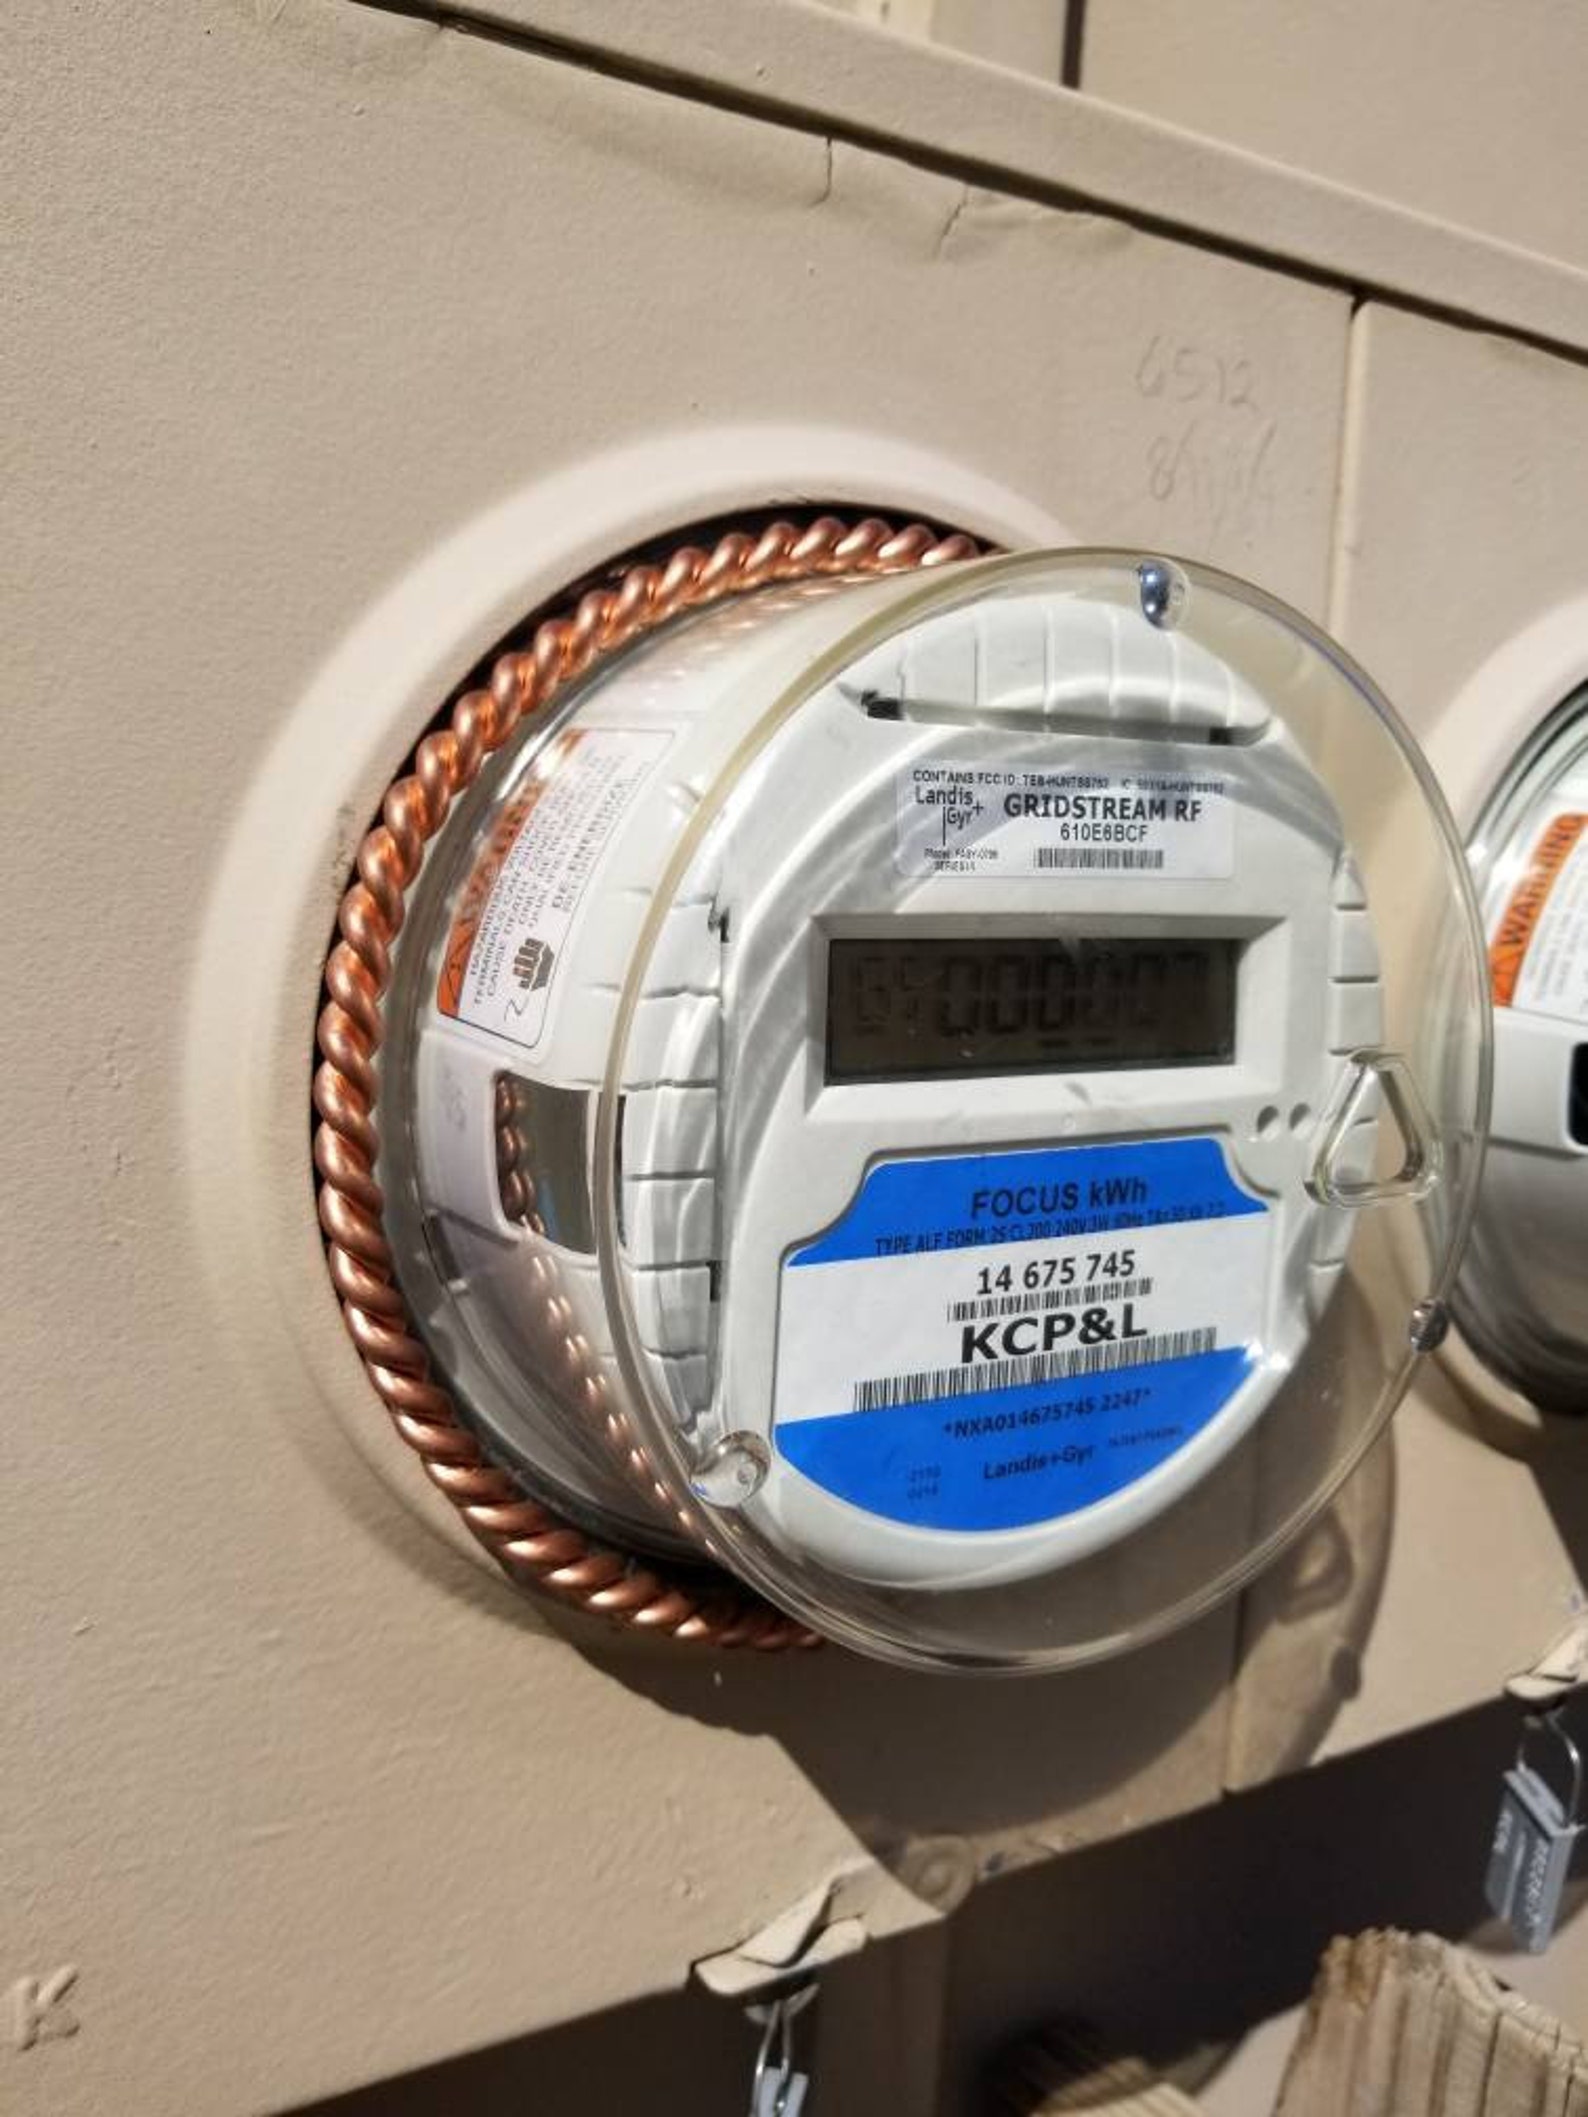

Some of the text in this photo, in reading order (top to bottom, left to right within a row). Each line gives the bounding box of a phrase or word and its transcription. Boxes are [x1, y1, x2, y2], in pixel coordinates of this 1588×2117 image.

[914, 785, 973, 805] Landis
[1004, 793, 1202, 822] GRIDSTREAM RF
[971, 1176, 1147, 1220] FOCUS kWh
[875, 1235, 912, 1256] TYPE
[947, 1228, 986, 1249] FORM
[977, 1249, 1136, 1295] 14 675 745
[961, 1304, 1147, 1363] KCP&L
